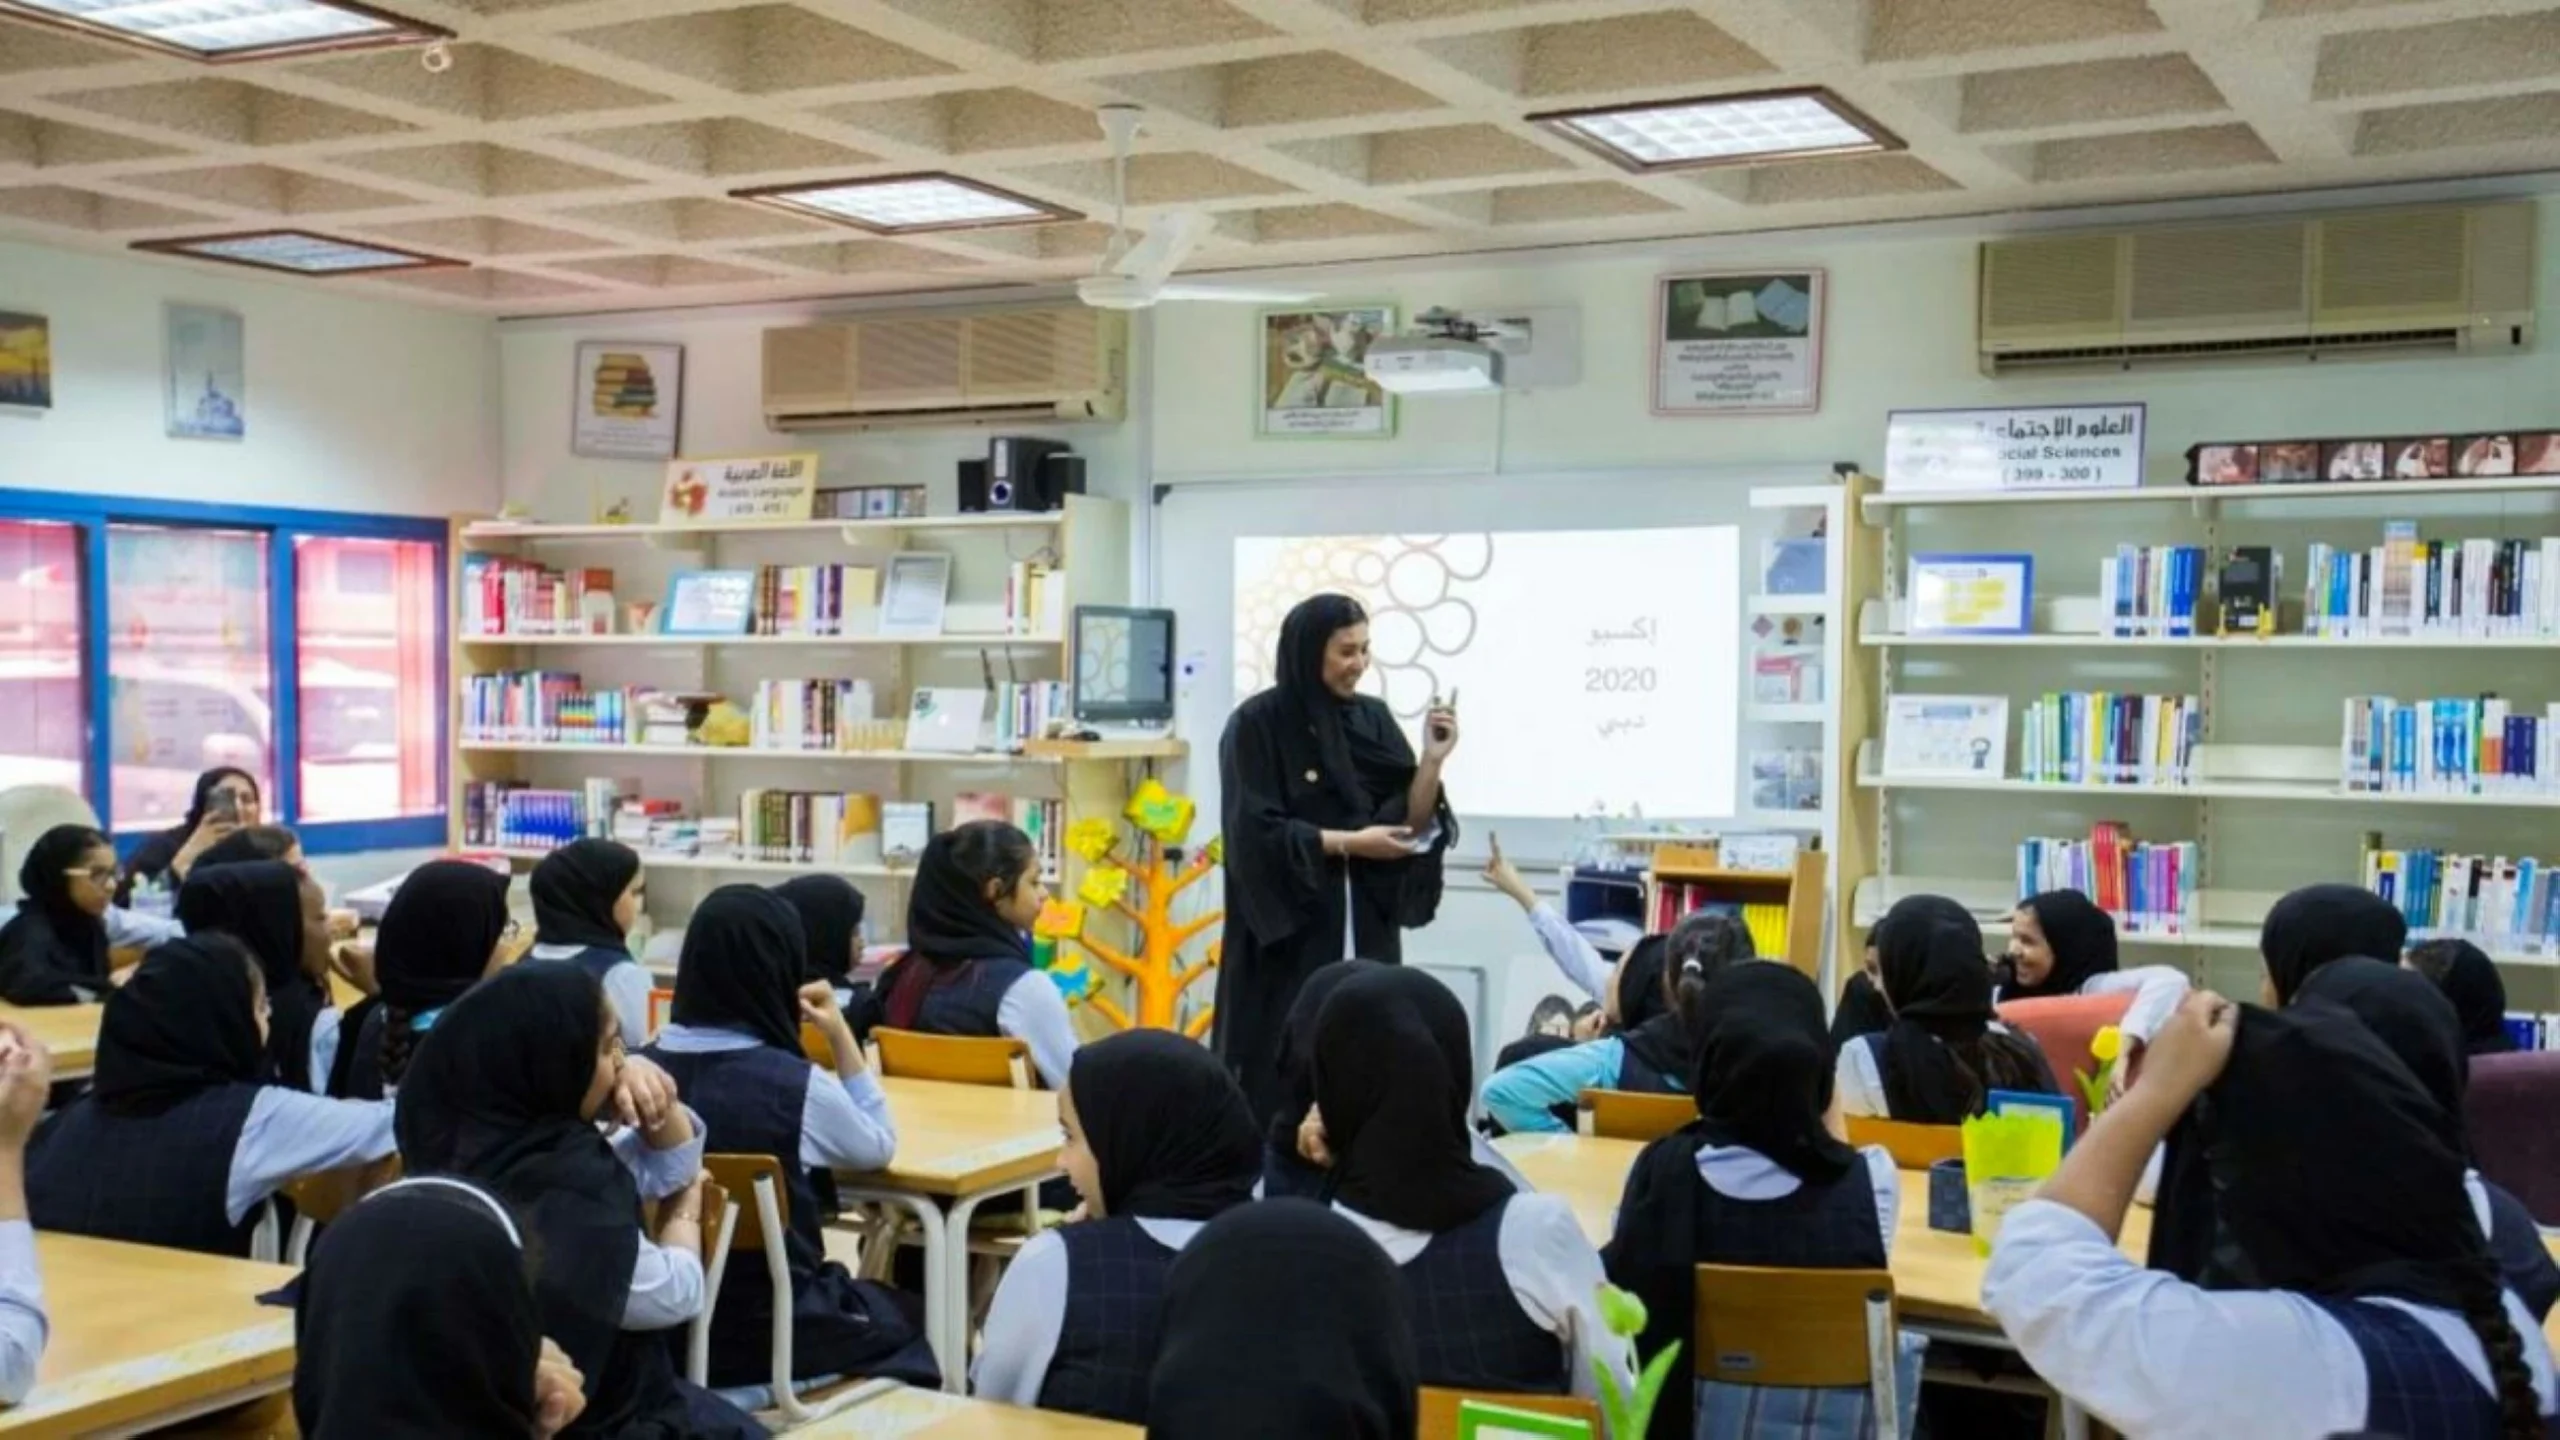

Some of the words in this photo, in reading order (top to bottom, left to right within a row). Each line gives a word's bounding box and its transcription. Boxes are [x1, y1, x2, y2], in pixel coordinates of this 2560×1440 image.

[1975, 415, 2073, 443] الإجتماع
[2077, 413, 2134, 438] العلوم
[1998, 445, 2038, 460] ocial
[2043, 446, 2121, 460] Sciences
[1585, 615, 1658, 647] إكسبو
[1585, 666, 1658, 692] 2020
[1595, 714, 1646, 741] دبي
